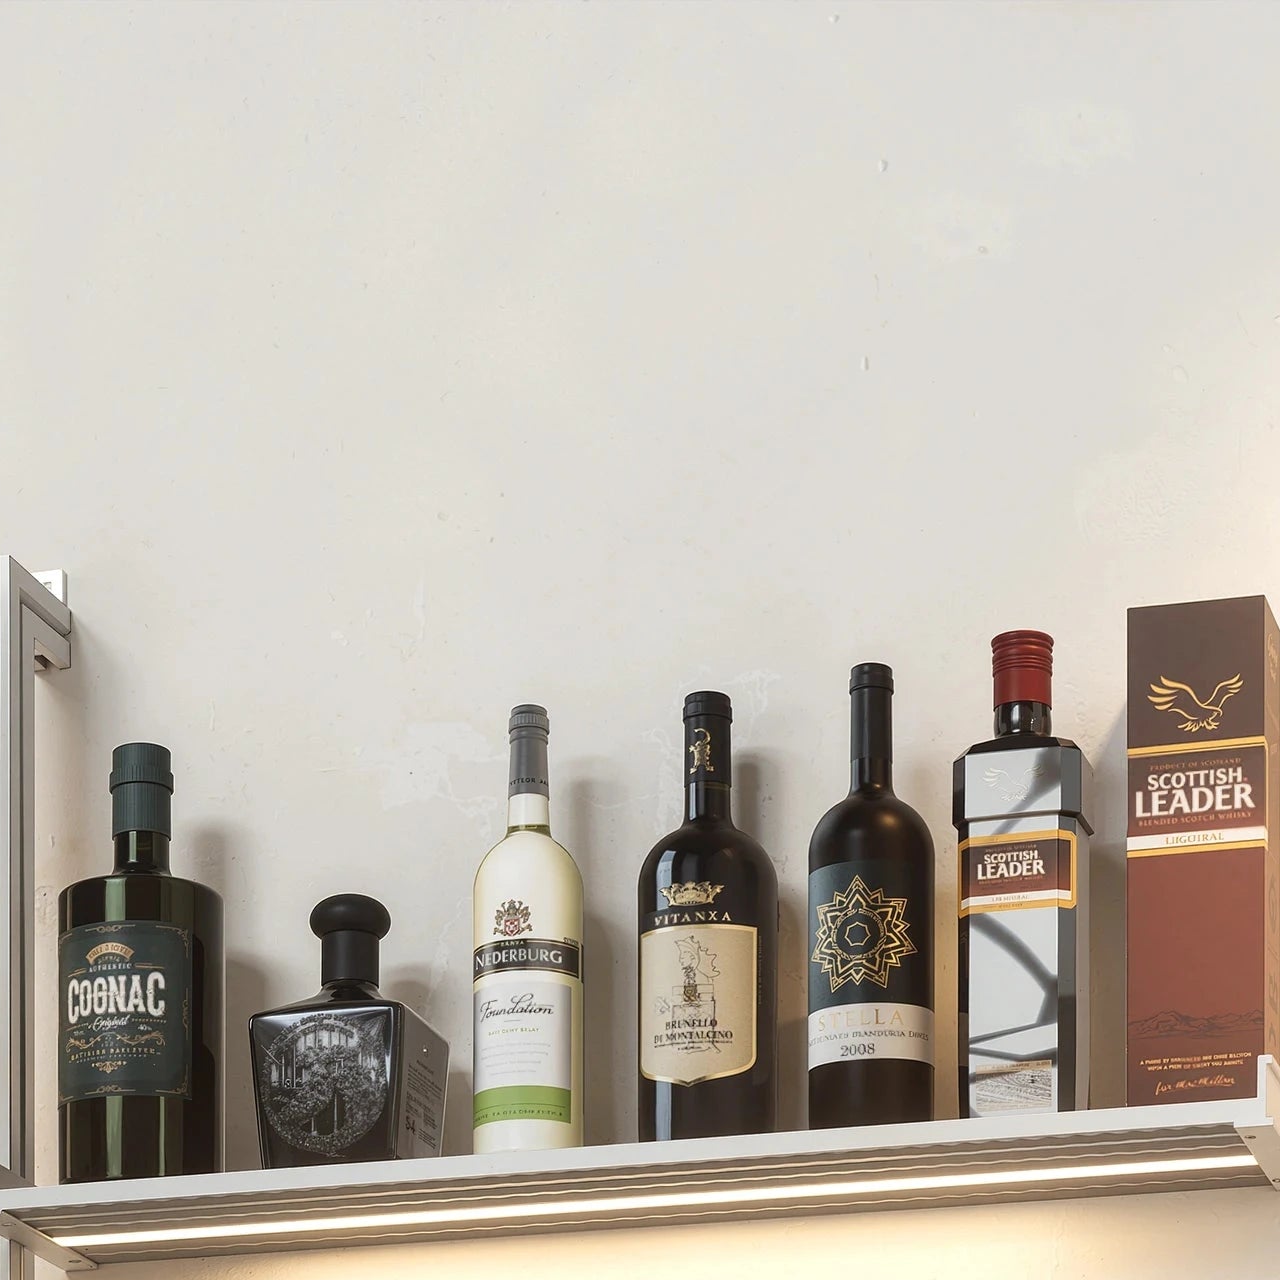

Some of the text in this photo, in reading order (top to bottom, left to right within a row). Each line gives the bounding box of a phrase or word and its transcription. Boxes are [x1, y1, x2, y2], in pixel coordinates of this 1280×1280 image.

[1147, 767, 1242, 791] SCOTTISH
[1135, 783, 1256, 818] LEADER
[984, 850, 1039, 864] SCOTTISH
[977, 860, 1045, 880] LEADER
[475, 948, 562, 970] NEDERBURG
[68, 971, 166, 1024] COGNAC
[480, 993, 555, 1023] Foundation
[665, 1018, 717, 1031] BRUNELLO
[818, 1008, 905, 1032] STELLA
[665, 1030, 733, 1043] MONTALCINO
[840, 1043, 875, 1057] 2008
